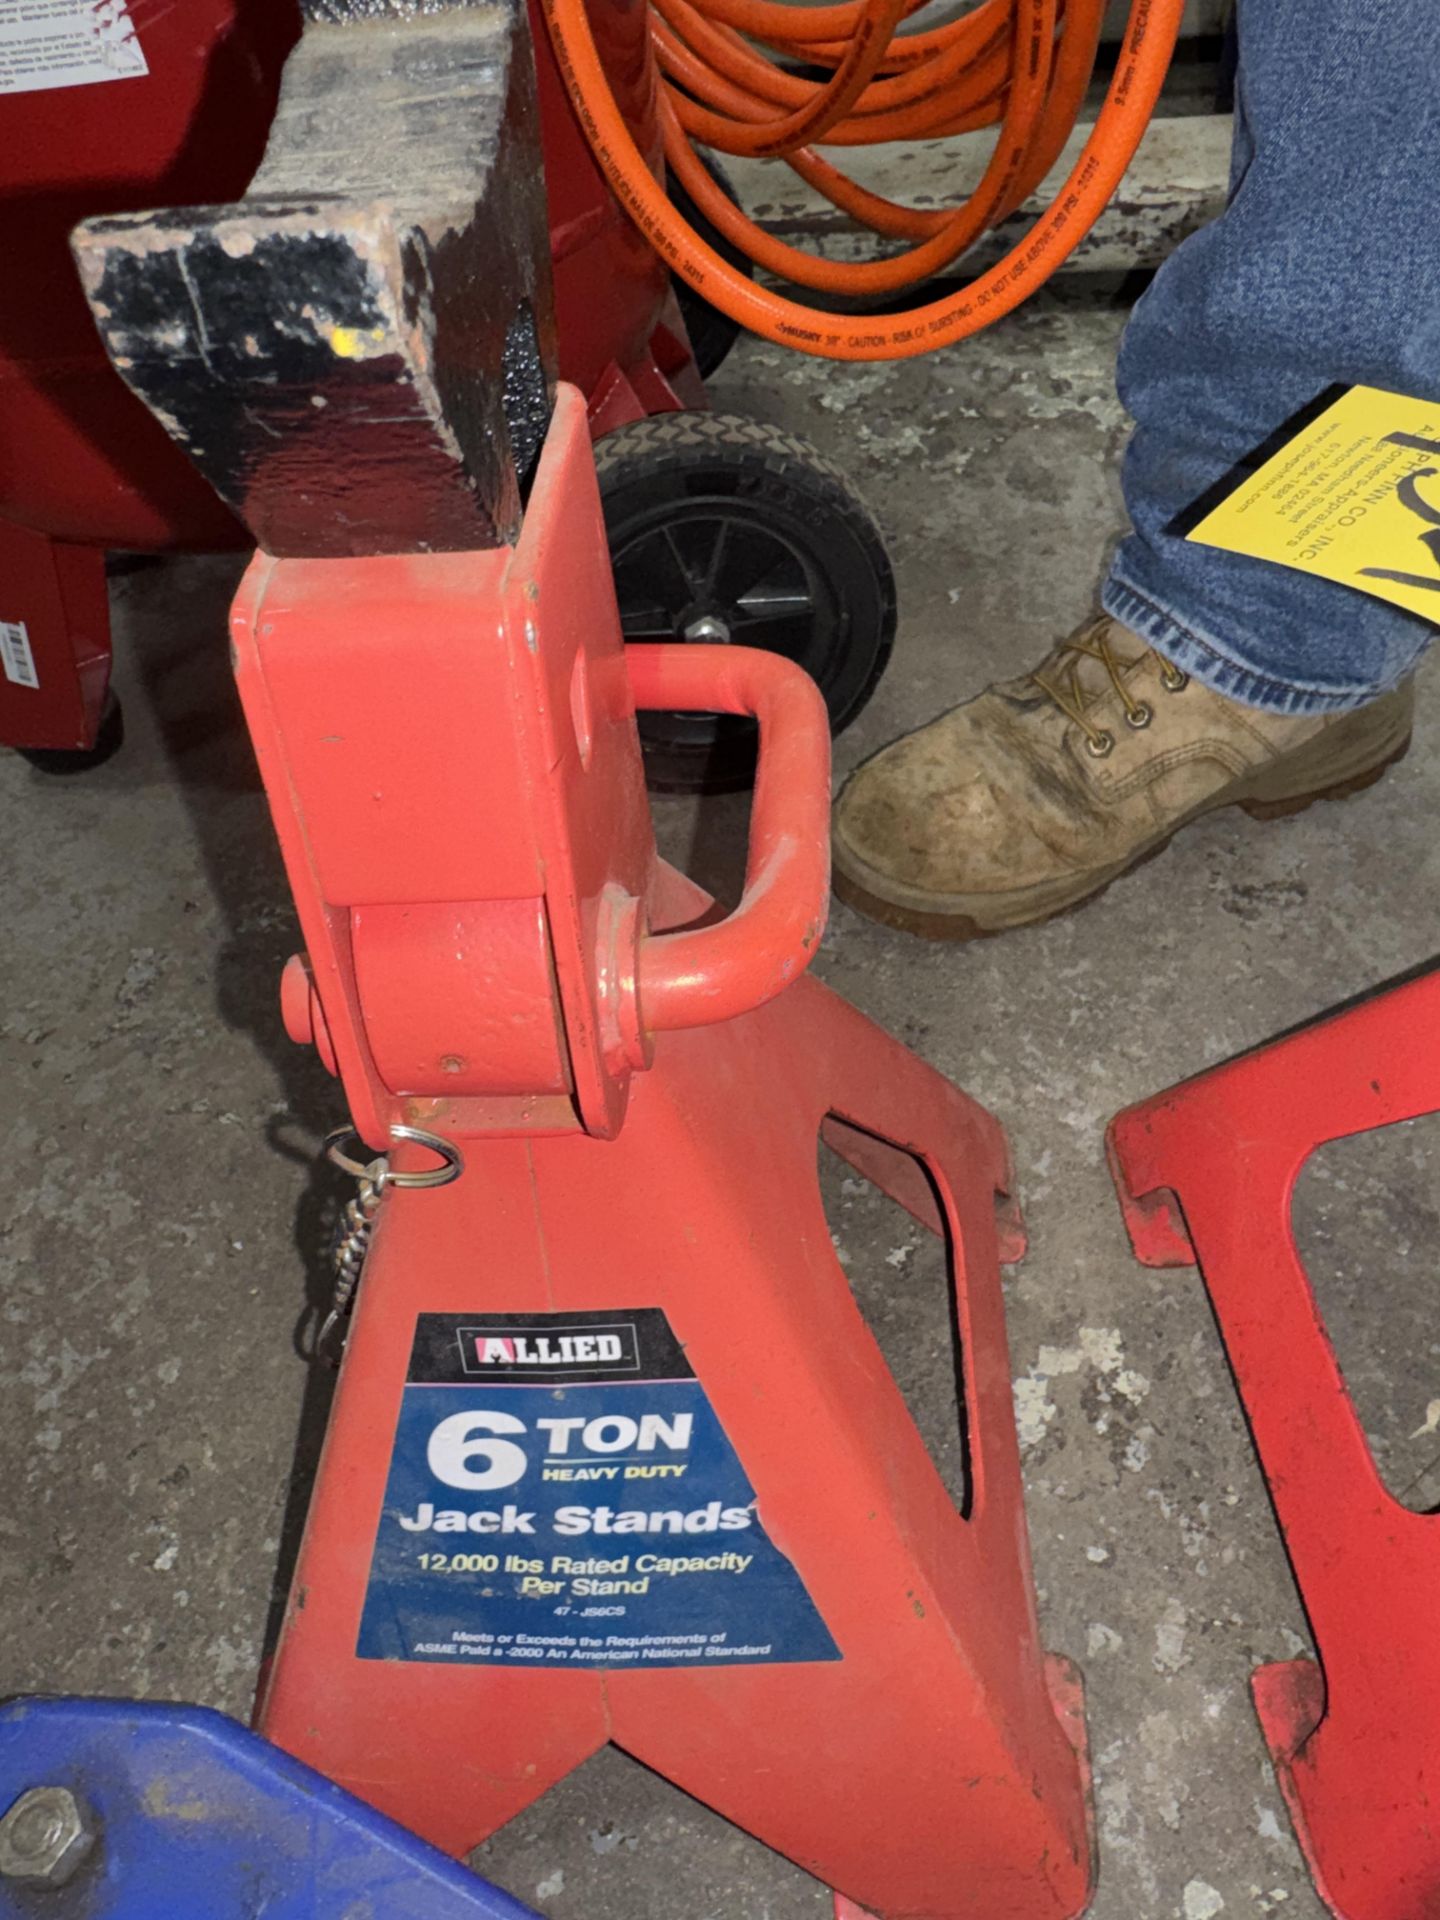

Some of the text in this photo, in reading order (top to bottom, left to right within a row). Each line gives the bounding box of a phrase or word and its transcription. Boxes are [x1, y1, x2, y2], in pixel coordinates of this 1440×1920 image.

[783, 325, 822, 342] HUSKY
[848, 335, 886, 348] CAUTION
[893, 330, 912, 344] RISK
[928, 304, 973, 334] BURSTING
[977, 290, 991, 306] DO
[992, 275, 1012, 294] NOT
[1008, 259, 1027, 281] USE
[1026, 228, 1056, 264] ABOVE
[1063, 193, 1079, 216] PSI
[1306, 473, 1330, 487] MA
[1289, 496, 1325, 523] Street
[1293, 535, 1334, 561] INC.
[475, 1334, 622, 1364] ALLIED
[427, 1410, 694, 1491] 6 TON
[542, 1464, 688, 1481] HEAVY DUTY
[400, 1501, 752, 1536] Jack Stands
[416, 1553, 754, 1576] 12,000 lbs Rated Capacity
[521, 1577, 650, 1597] Per Stand
[553, 1606, 571, 1616] 47
[452, 1631, 727, 1648] Meets or Exceeds the Requirements of
[414, 1643, 457, 1654] ASME
[546, 1648, 567, 1659] An
[570, 1648, 639, 1660] American
[642, 1646, 702, 1659] National
[705, 1644, 772, 1657] Standard
